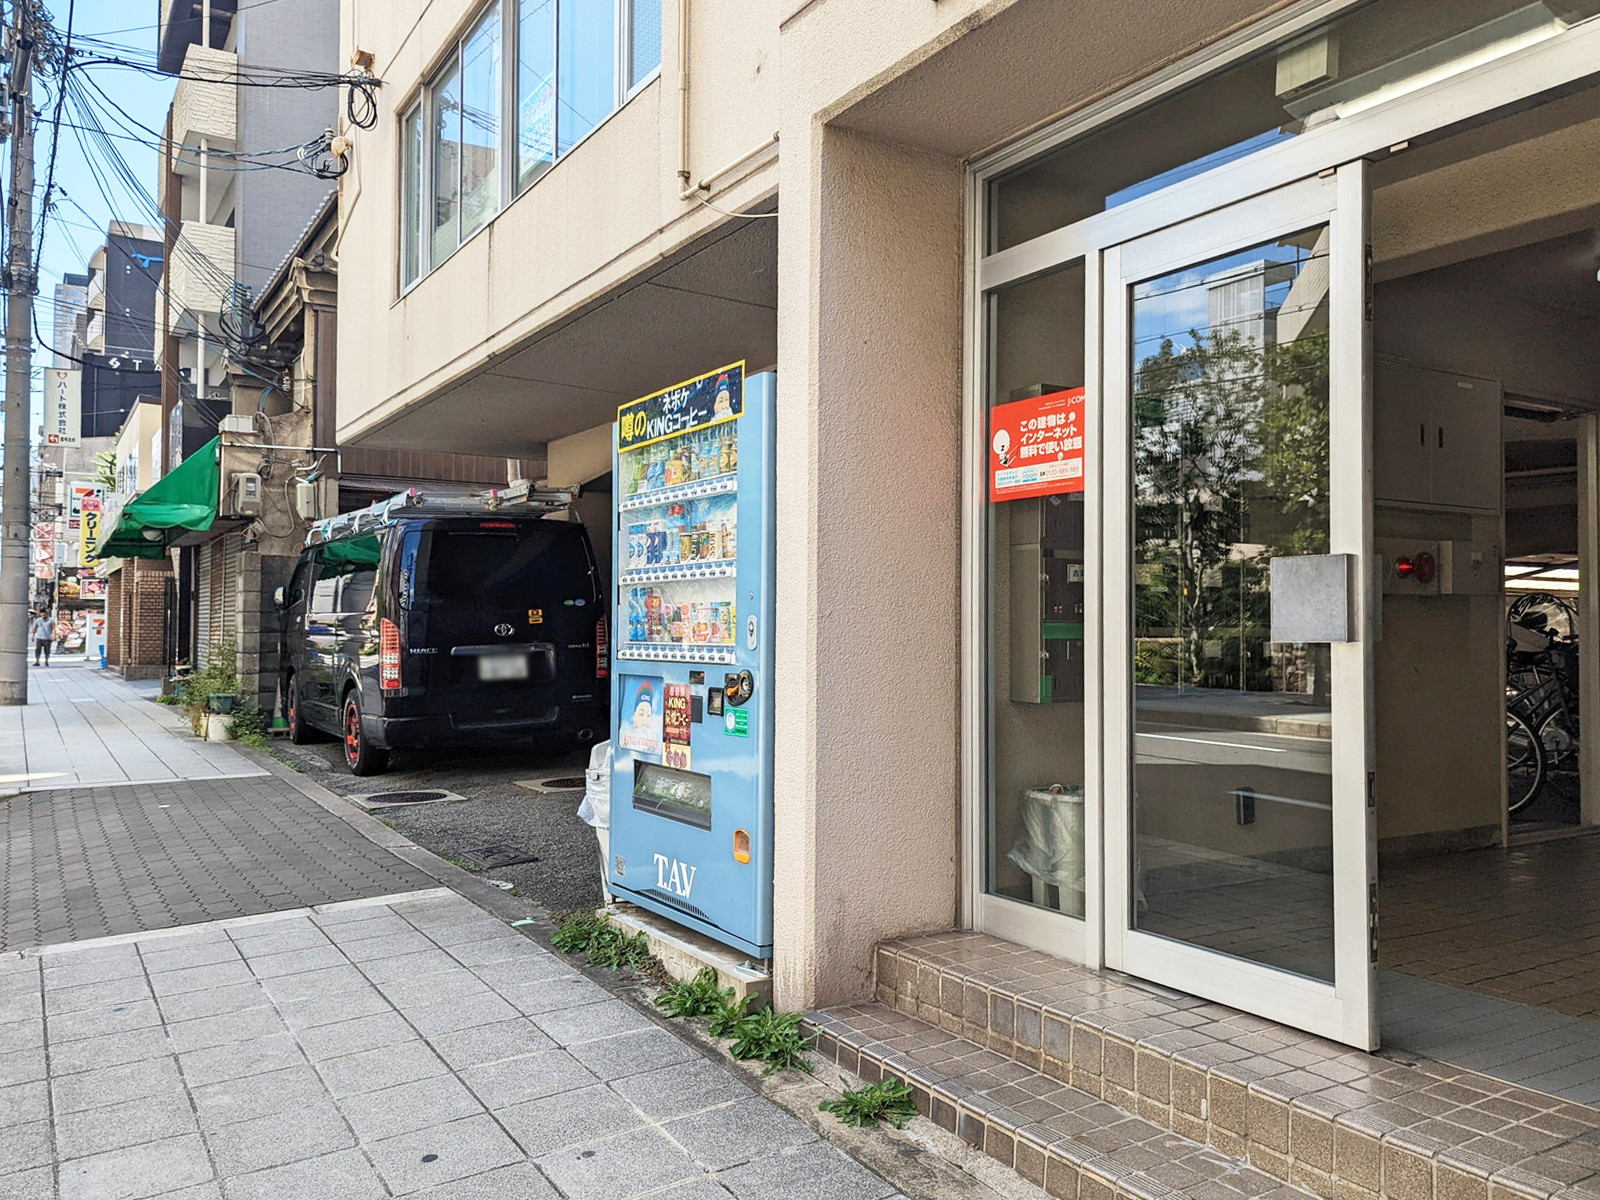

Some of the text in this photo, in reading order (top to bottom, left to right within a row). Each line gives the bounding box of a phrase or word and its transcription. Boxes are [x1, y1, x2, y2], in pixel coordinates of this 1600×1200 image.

[57, 381, 67, 434] ハート株式会社
[1020, 412, 1066, 432] この建物は
[1020, 423, 1078, 445] インターネット
[1020, 436, 1083, 459] 無料で使い放題
[85, 512, 98, 564] クリーニング
[669, 697, 687, 710] KING
